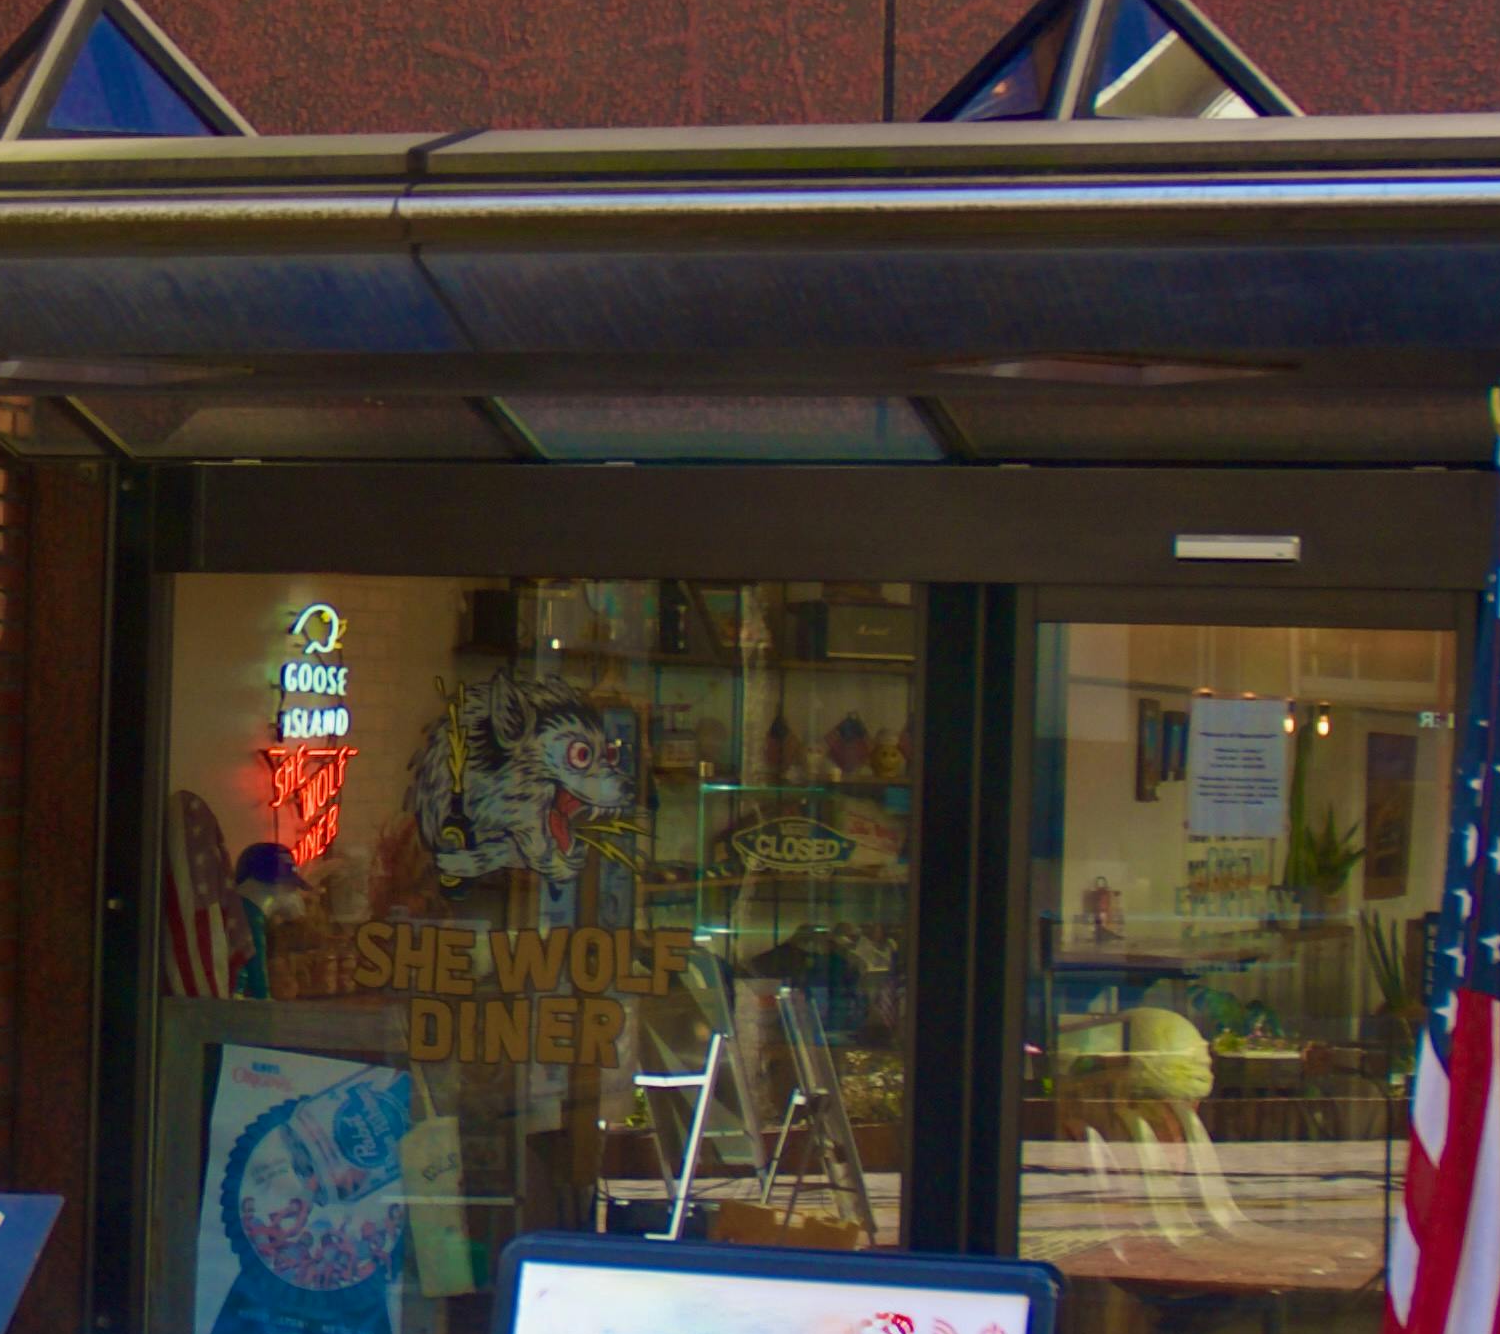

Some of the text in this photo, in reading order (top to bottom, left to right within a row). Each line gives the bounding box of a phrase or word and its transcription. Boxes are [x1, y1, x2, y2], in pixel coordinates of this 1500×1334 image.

[283, 663, 349, 697] GOOSE
[282, 706, 350, 738] ISLAND
[271, 744, 307, 808] SHE
[301, 746, 349, 822] WOLF
[754, 836, 840, 861] CLOSED
[352, 921, 694, 996] SHE WOLF
[409, 996, 627, 1069] DINER
